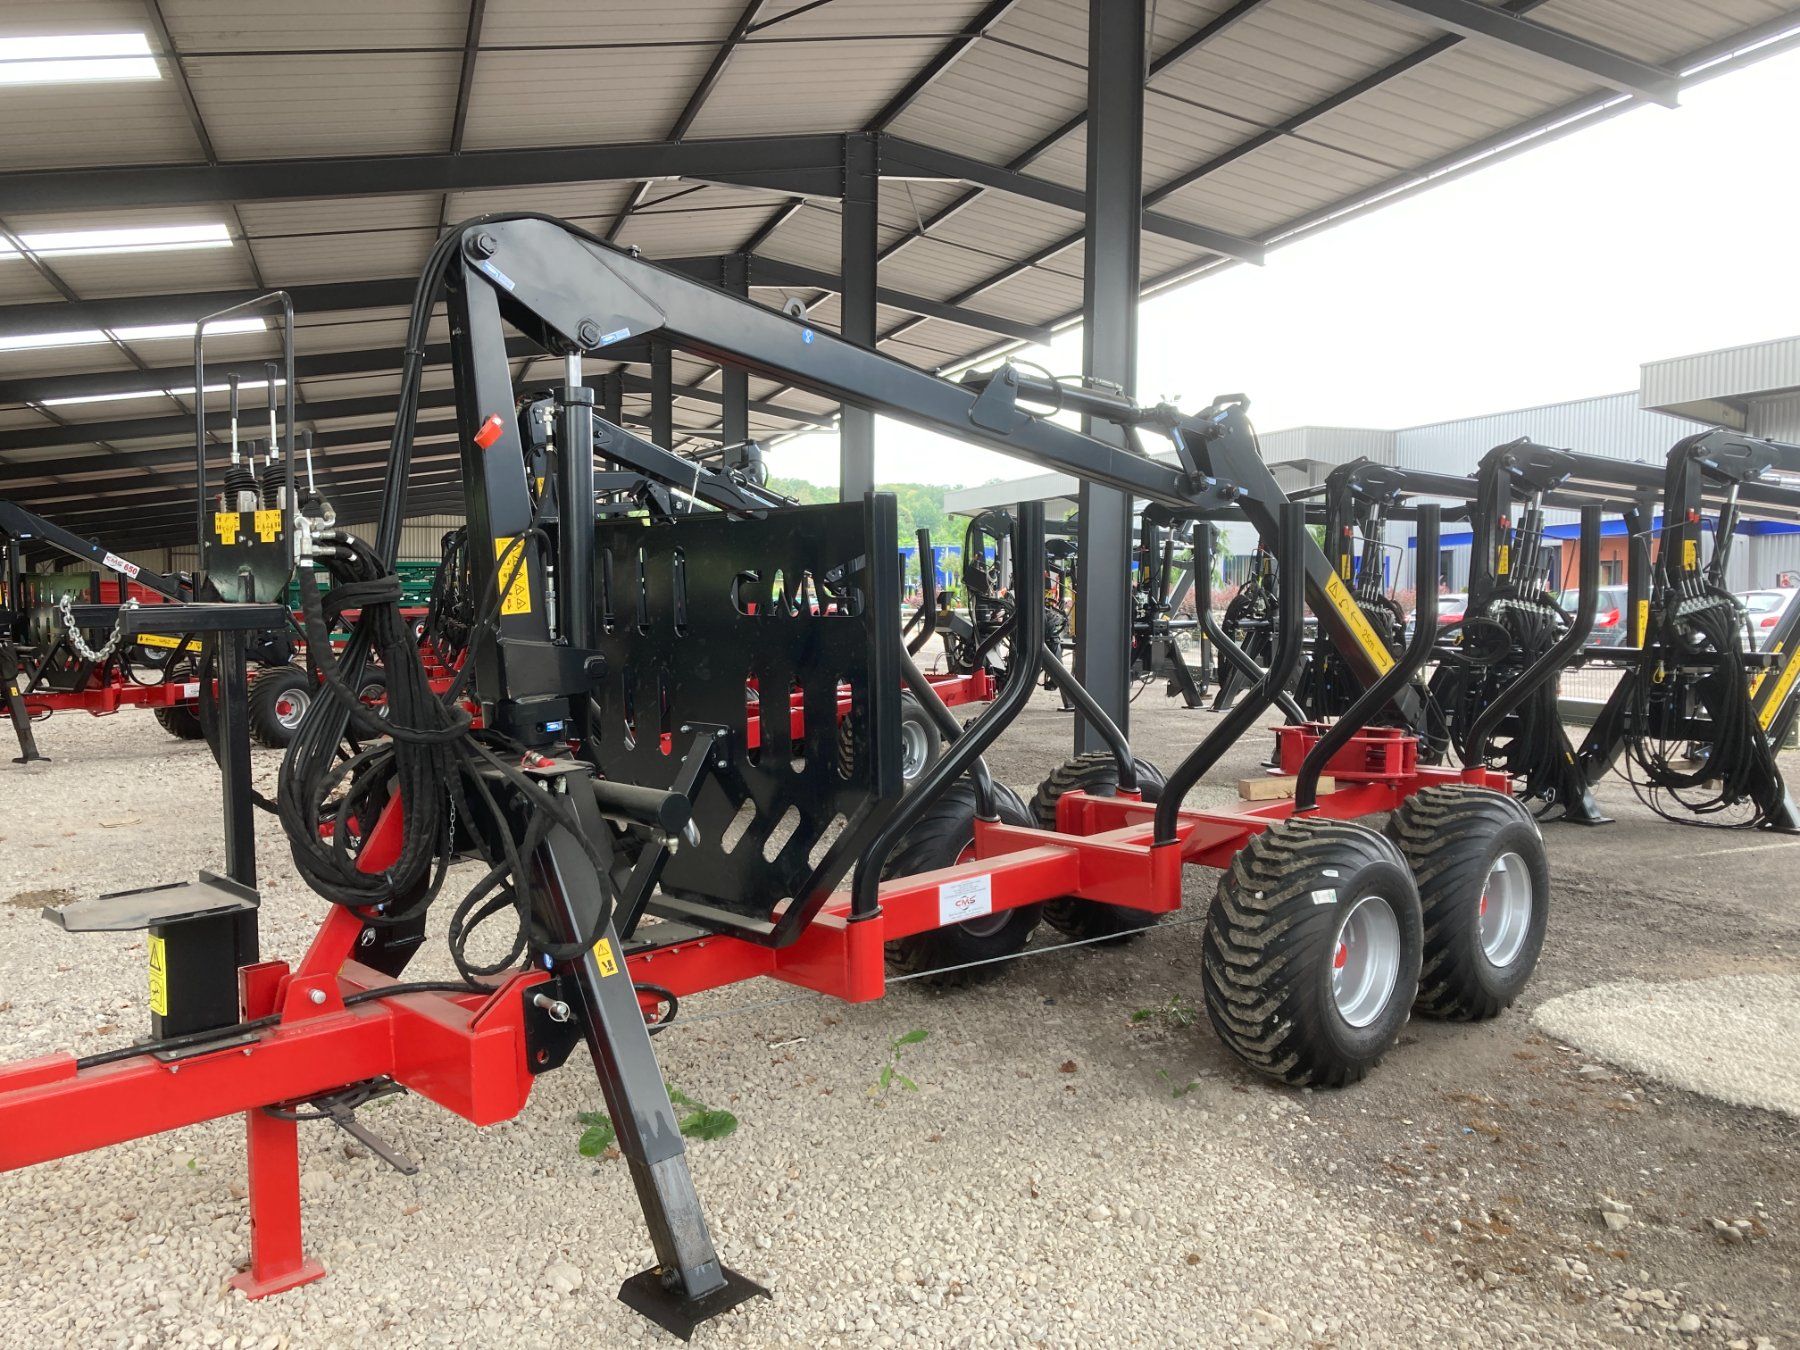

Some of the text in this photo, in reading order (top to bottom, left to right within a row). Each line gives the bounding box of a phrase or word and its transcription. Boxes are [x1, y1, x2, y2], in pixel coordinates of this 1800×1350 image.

[123, 563, 138, 575] 650
[730, 554, 866, 617] CMS
[1361, 628, 1375, 651] 25m
[955, 895, 976, 907] CMS
